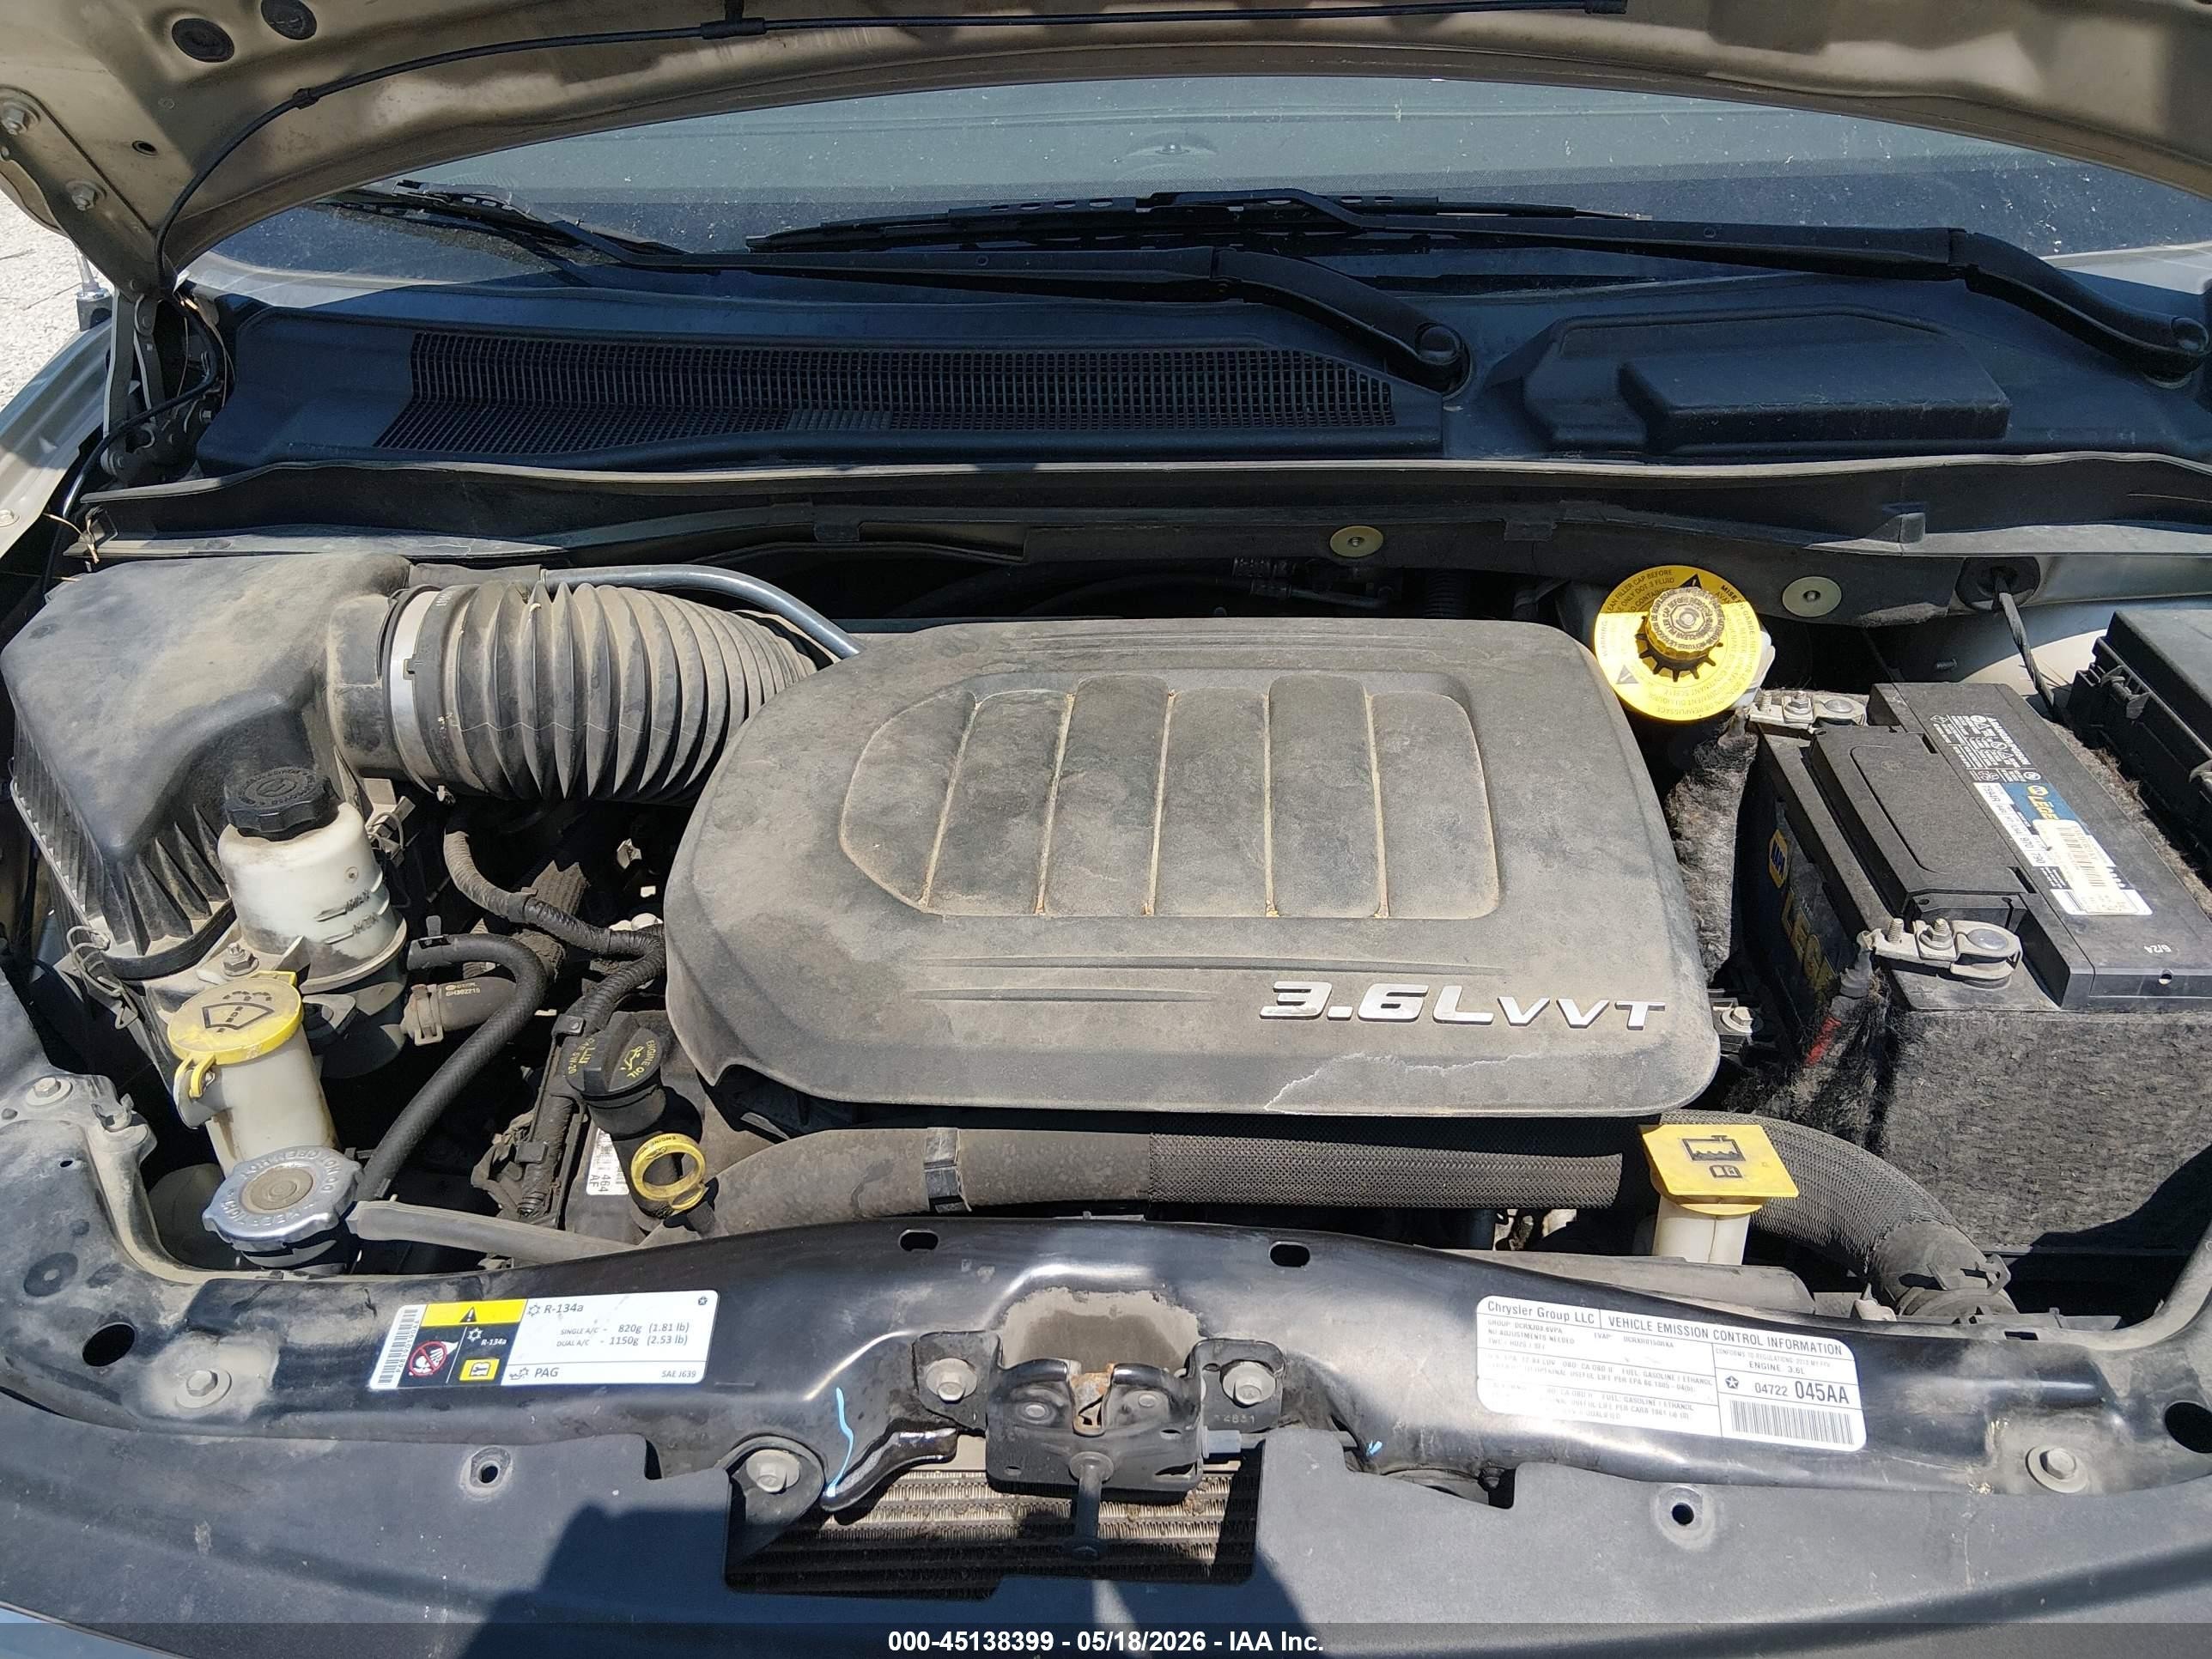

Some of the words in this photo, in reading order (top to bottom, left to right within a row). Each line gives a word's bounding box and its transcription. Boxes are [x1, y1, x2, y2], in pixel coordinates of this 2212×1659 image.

[1615, 584, 1634, 599] FILLER
[1633, 576, 1645, 586] CAP
[1648, 570, 1672, 579] BEFORE
[1621, 592, 1635, 606] ONLY
[1635, 585, 1648, 594] DOT
[1655, 577, 1674, 586] FLUID
[1719, 583, 1738, 600] MISE
[2020, 836, 2033, 850] 970
[646, 1039, 657, 1066] ENGINE
[627, 1066, 645, 1079] OIL
[590, 1175, 599, 1188] AF
[600, 1175, 611, 1193] 464
[544, 1303, 584, 1314] R-134a
[1486, 1300, 1533, 1317] Chrysler
[1536, 1306, 1570, 1322] Group
[1574, 1311, 1595, 1324] LLC
[618, 1324, 642, 1334] 820g
[648, 1323, 673, 1334] (1.81
[675, 1322, 690, 1333] lb)
[481, 1338, 507, 1346] R-134a
[609, 1336, 639, 1346] 1150g
[647, 1336, 673, 1346] (2.53
[675, 1334, 688, 1346] lb)
[1607, 1316, 1654, 1331] VEHICLE
[1657, 1322, 1709, 1338] EMISSION
[1712, 1328, 1765, 1346] CONTROL
[1767, 1335, 1843, 1356] INFORMATION
[534, 1367, 559, 1377] PAG
[678, 1370, 696, 1379] J639
[1787, 1365, 1805, 1375] 3.6L
[1754, 1382, 1789, 1396] 04722
[1793, 1380, 1851, 1405] 045AA
